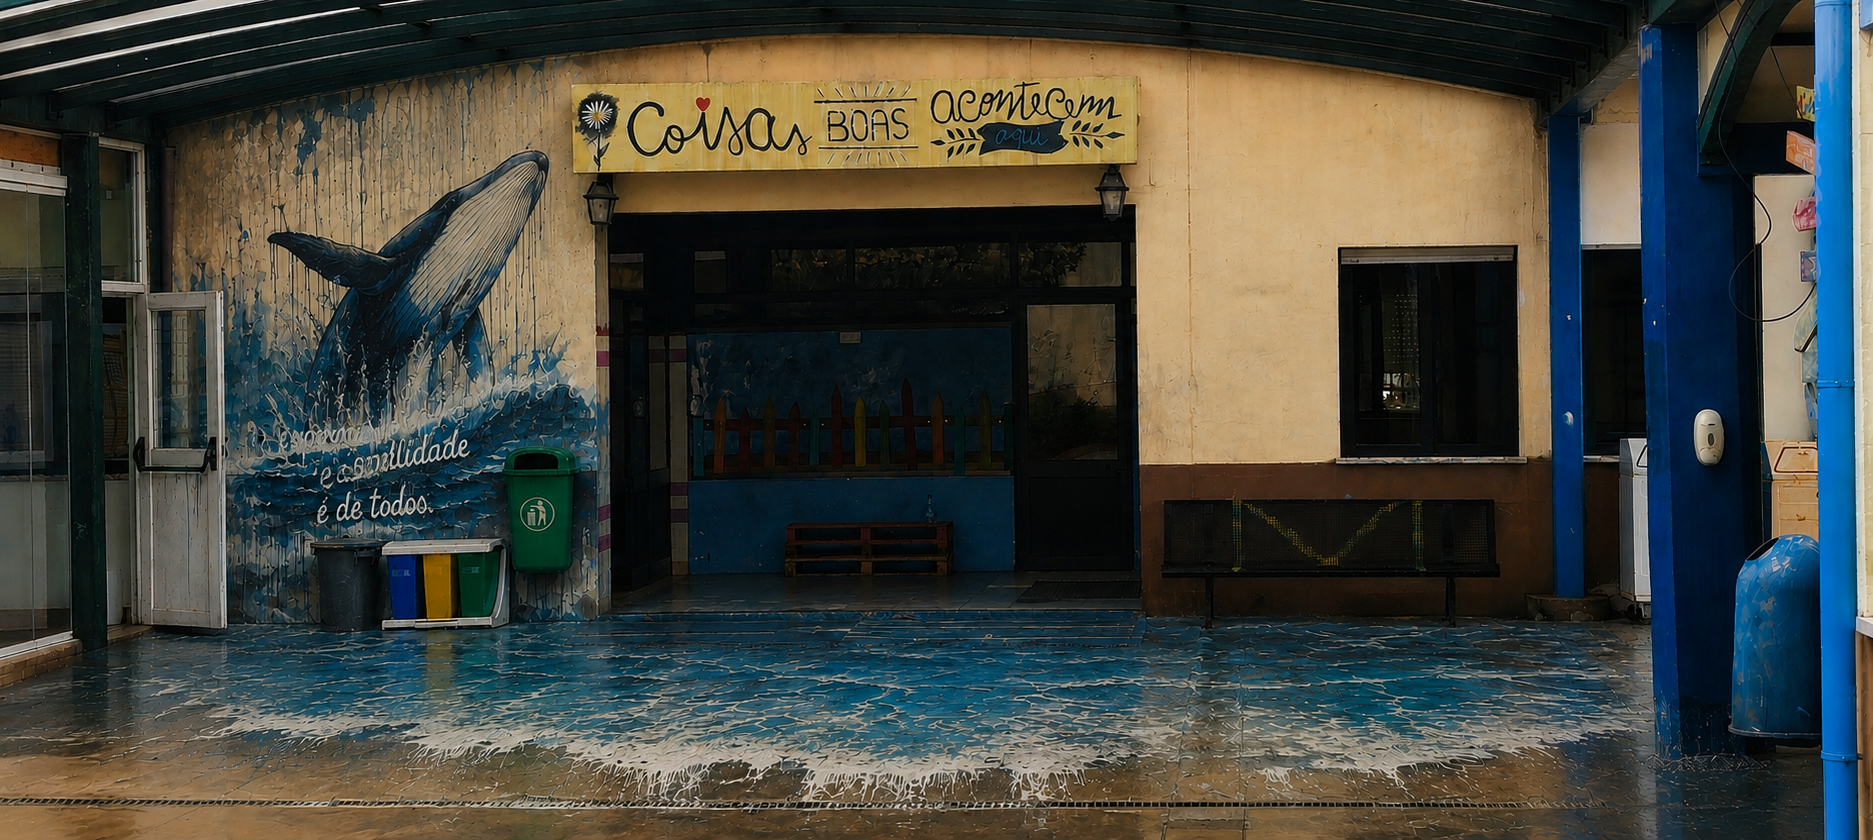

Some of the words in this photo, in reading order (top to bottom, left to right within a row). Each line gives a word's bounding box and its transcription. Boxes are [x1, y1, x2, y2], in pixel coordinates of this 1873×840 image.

[626, 97, 813, 157] Coisas
[826, 108, 910, 142] BOAS
[995, 127, 1050, 150] aqui
[316, 496, 330, 525] é
[336, 490, 364, 522] de
